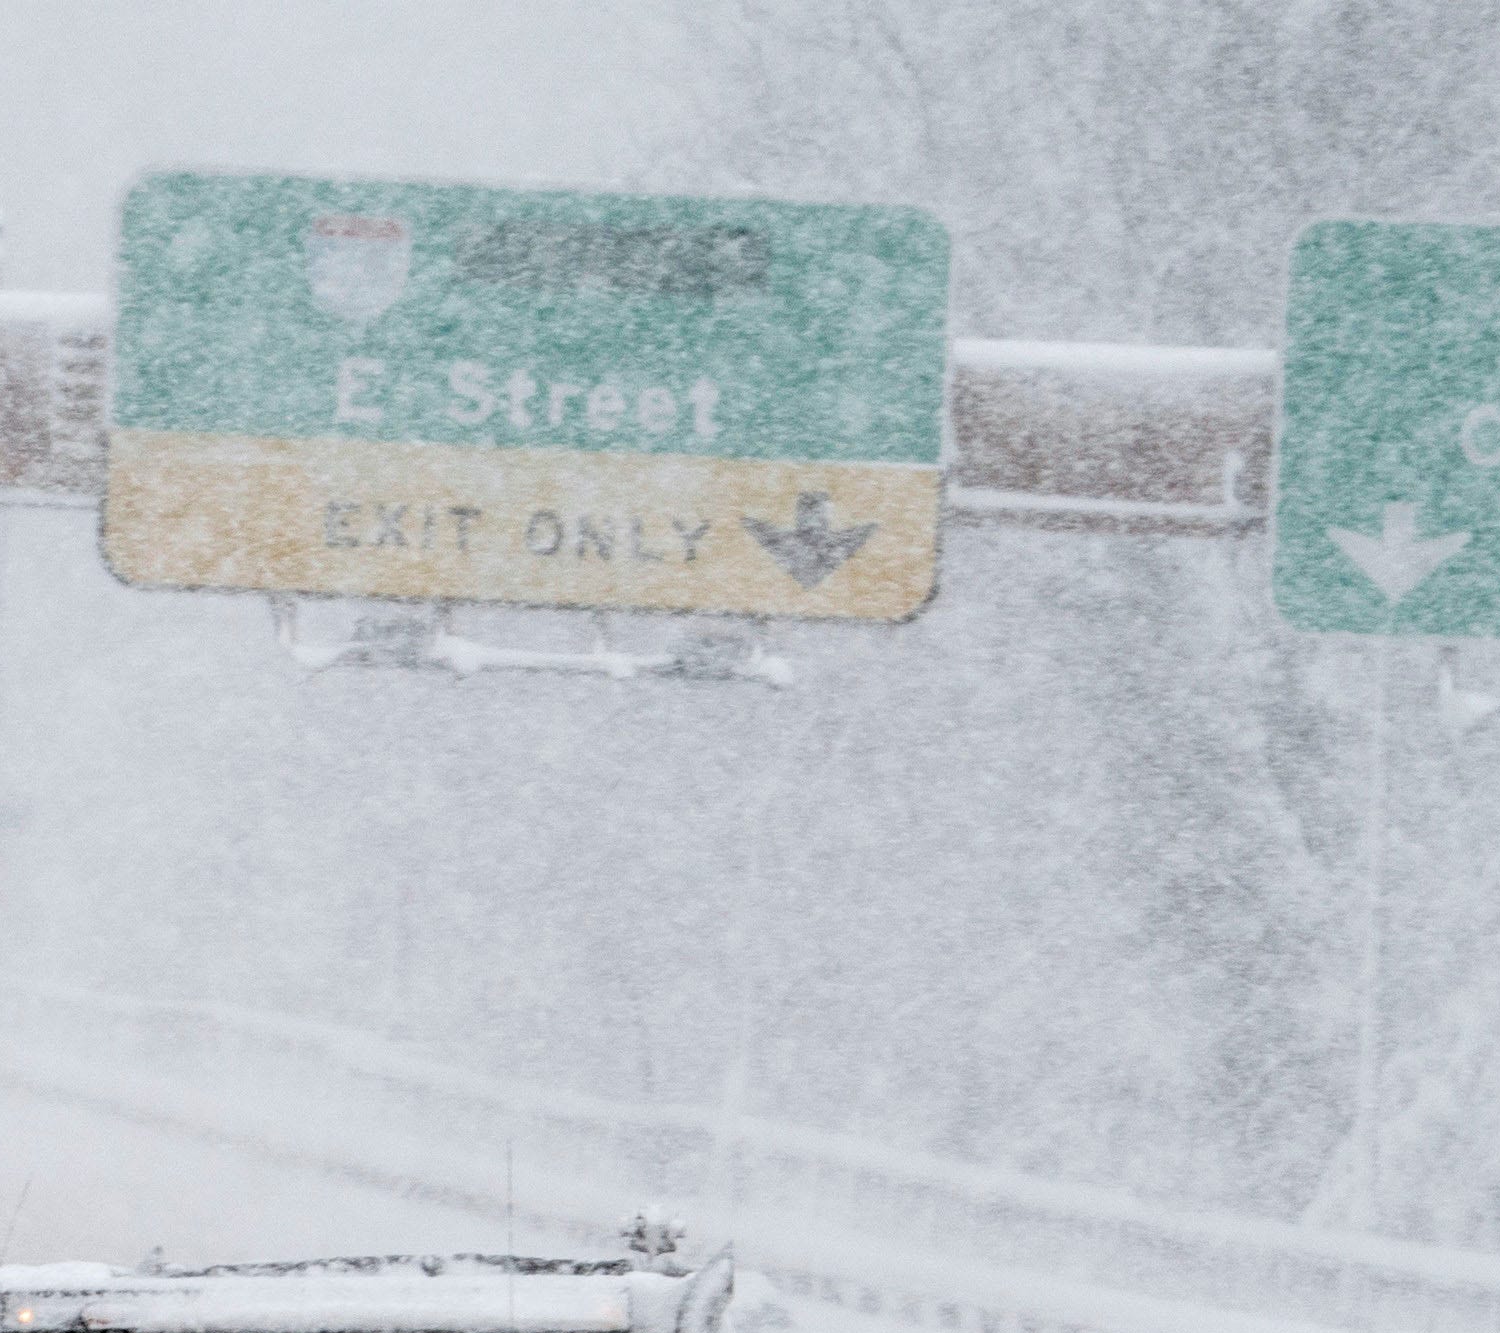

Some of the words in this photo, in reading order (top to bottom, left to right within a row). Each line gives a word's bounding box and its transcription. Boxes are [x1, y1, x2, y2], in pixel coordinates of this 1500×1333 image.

[335, 355, 386, 424] E
[448, 360, 722, 438] Street
[322, 499, 483, 555] EXIT
[524, 508, 714, 565] ONLY
